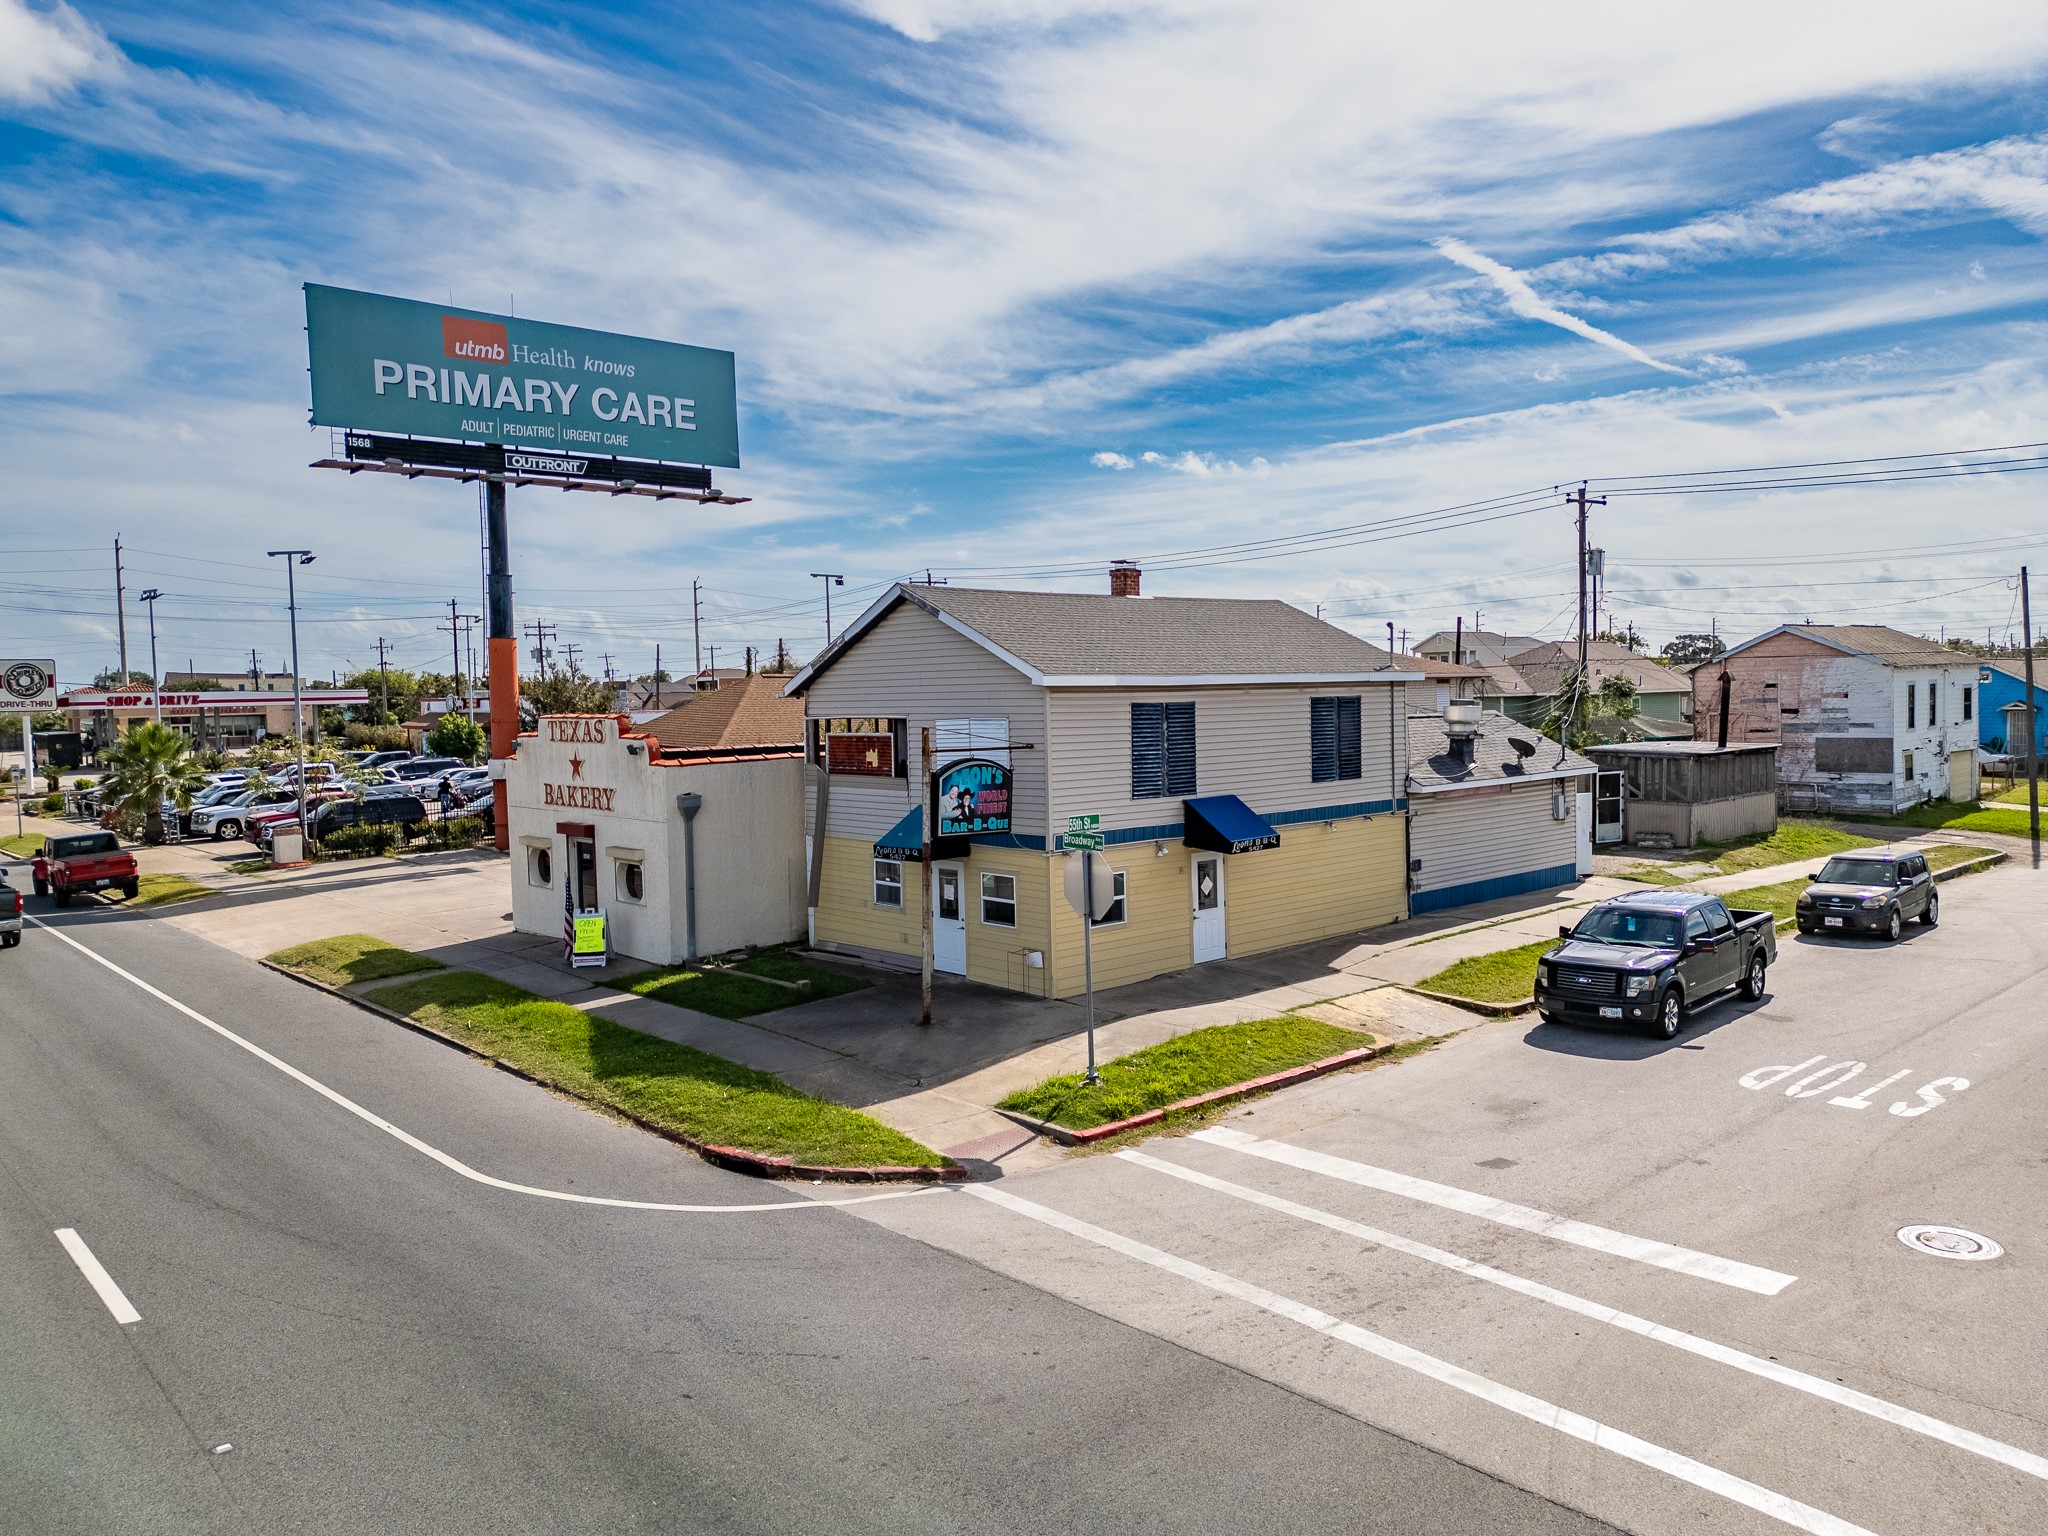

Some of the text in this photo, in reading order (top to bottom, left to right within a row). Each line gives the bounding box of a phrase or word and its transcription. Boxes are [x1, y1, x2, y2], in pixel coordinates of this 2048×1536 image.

[455, 340, 636, 378] utmb Health knows
[373, 358, 698, 431] PRIMARY CARE
[461, 419, 629, 447] ADULT PEDIATRIC URGENT CARE
[348, 436, 371, 448] 1568
[511, 456, 580, 473] OUTFRONT
[106, 695, 200, 706] SHOP & DRIVE
[547, 719, 606, 744] TEXAS
[951, 766, 1003, 786] LEON'S
[543, 783, 618, 812] BAKERY
[977, 789, 1008, 802] WORLD
[977, 802, 1008, 814] FINEST
[1069, 818, 1083, 831] 55th
[1064, 833, 1095, 849] Broadway
[579, 919, 597, 928] OPEN
[1738, 1054, 1970, 1117] STOP
